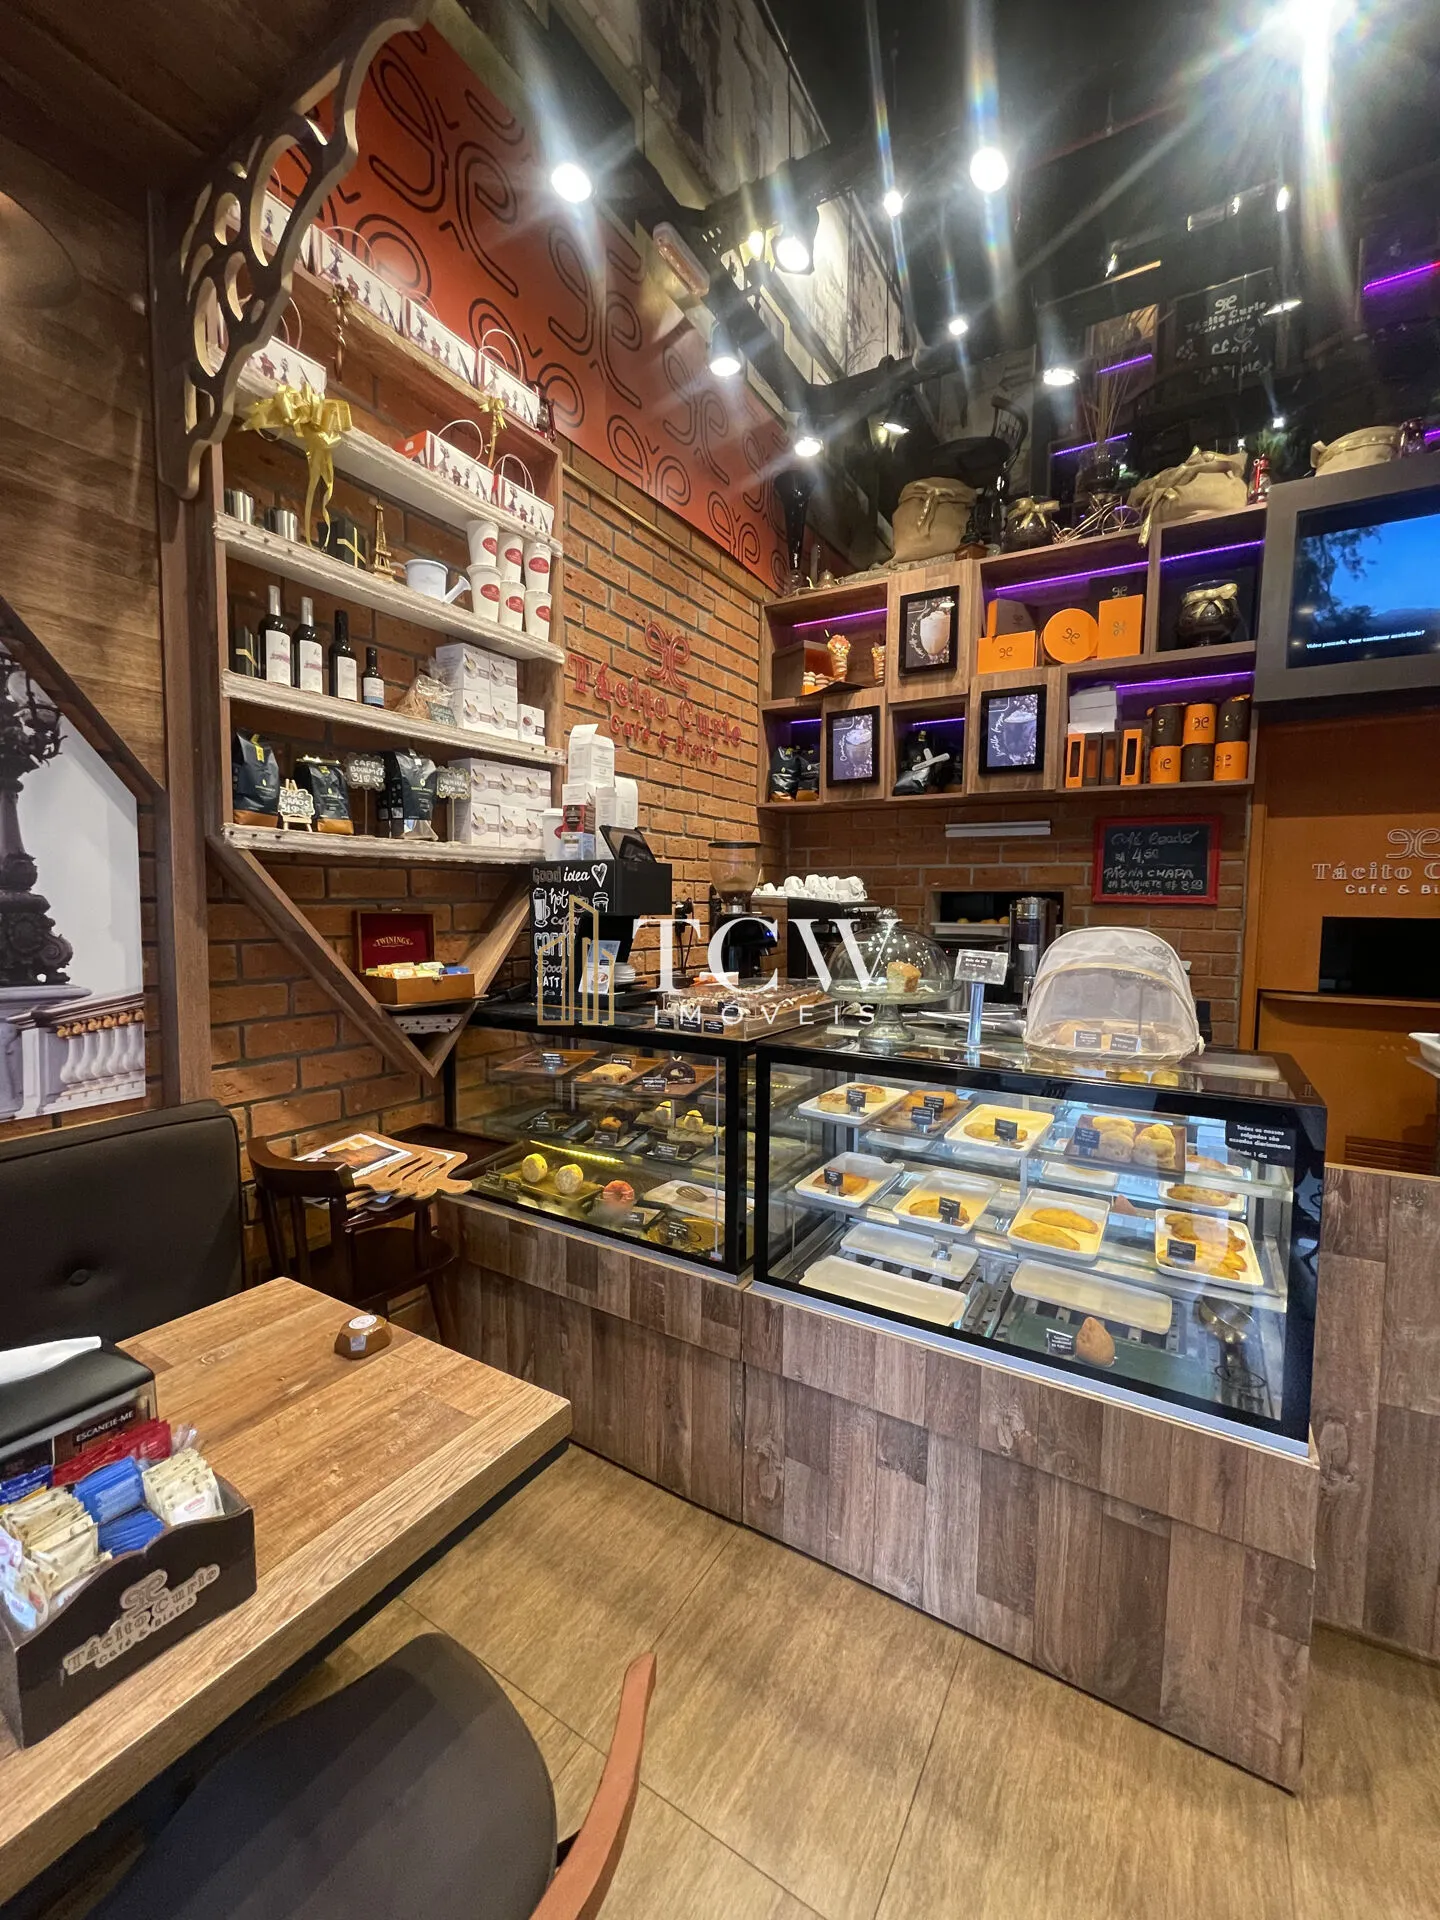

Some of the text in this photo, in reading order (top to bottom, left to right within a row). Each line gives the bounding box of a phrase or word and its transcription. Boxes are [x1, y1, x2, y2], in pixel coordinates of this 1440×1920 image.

[568, 653, 742, 748] Tácito Curie
[532, 866, 591, 885] Good idea
[1147, 868, 1195, 880] CHAPA
[1312, 860, 1413, 881] Tácito
[1397, 884, 1411, 895] &
[549, 887, 570, 914] hot
[375, 935, 411, 947] TWININGS
[1236, 1124, 1254, 1132] Todos
[76, 1409, 134, 1442] ESCANEIE-ME
[66, 1568, 218, 1673] Tácito Curie
